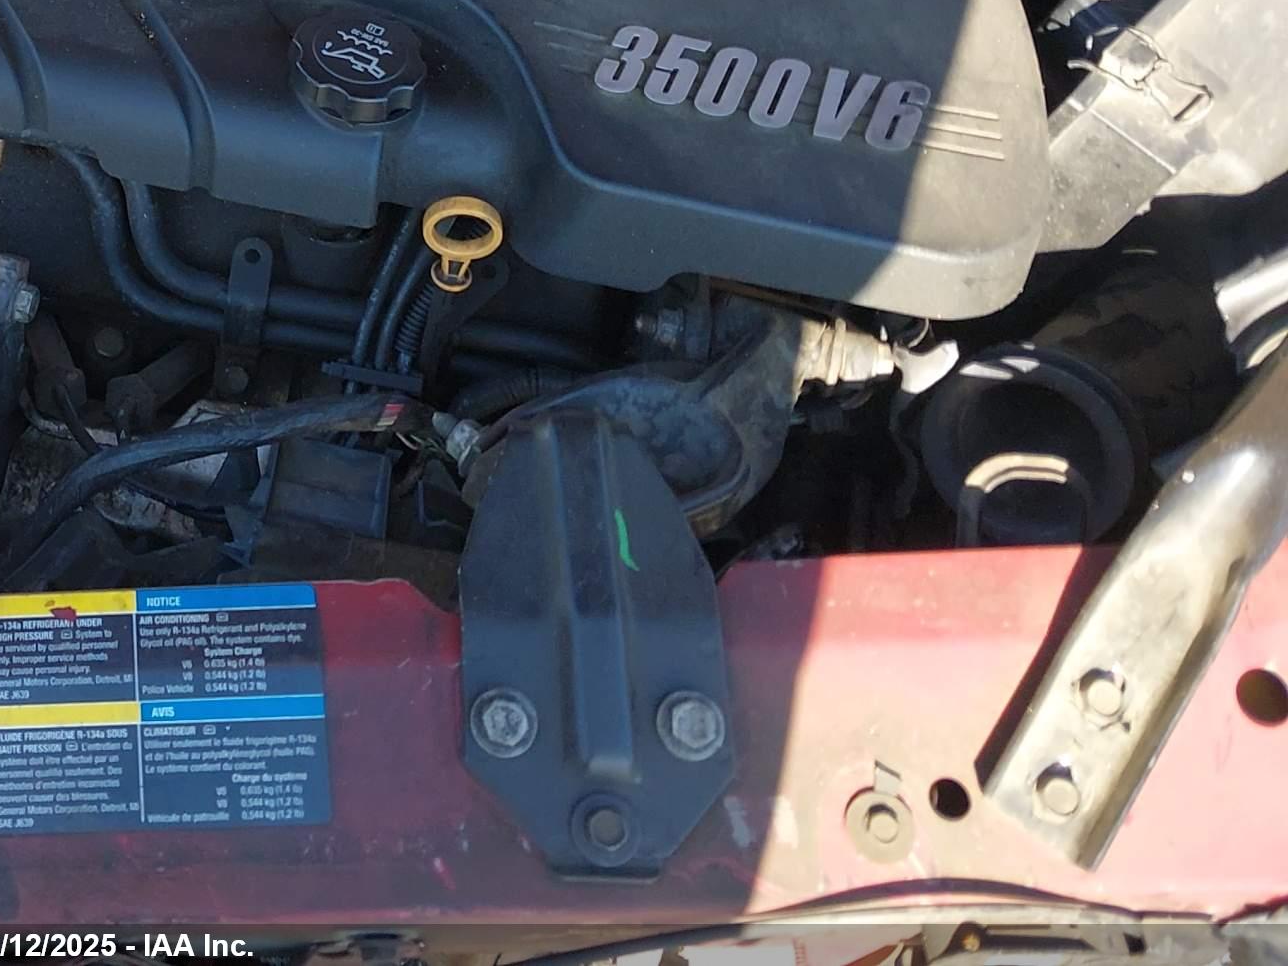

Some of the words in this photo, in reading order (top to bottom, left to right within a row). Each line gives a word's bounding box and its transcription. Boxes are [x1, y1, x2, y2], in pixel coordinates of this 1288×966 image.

[147, 596, 181, 607] NOTICE
[76, 618, 102, 627] UNDER
[139, 615, 152, 625] AIR
[154, 614, 209, 624] CONDITIONING
[14, 631, 53, 641] PRESSURE
[75, 630, 103, 640] System
[140, 627, 154, 636] Use
[156, 627, 171, 638] only
[173, 626, 200, 635] R-134a
[201, 624, 243, 636] Refrigerant
[244, 624, 258, 633] and
[5, 644, 36, 652] serviced
[38, 643, 46, 653] by
[48, 642, 80, 652] qualified
[82, 640, 118, 651] personnel
[140, 639, 162, 649] Glycol
[164, 637, 174, 646] oil
[175, 636, 193, 647] (PAG
[210, 636, 224, 645] The
[226, 636, 252, 646] system
[253, 634, 285, 643] contains
[13, 655, 46, 665] Improper
[48, 654, 74, 662] service
[76, 652, 108, 662] methods
[204, 648, 233, 659] System
[234, 647, 262, 656] Charge
[182, 660, 192, 669] V6
[204, 659, 226, 668] 0.635
[227, 658, 237, 670] kg
[238, 658, 254, 668] (1.4
[255, 657, 265, 667] lb)
[12, 667, 32, 675] cause
[35, 665, 67, 676] personal
[205, 670, 226, 680] 0.544
[228, 670, 238, 682] kg
[239, 669, 254, 680] (1.2
[255, 669, 266, 680] lb)
[24, 678, 48, 686] Motors
[124, 674, 132, 682] MI
[142, 685, 165, 695] Police
[166, 684, 193, 693] Vehicle
[205, 682, 227, 692] 0.544
[229, 682, 239, 694] kg
[240, 681, 255, 692] (1.2
[256, 681, 266, 692] lb)
[11, 690, 29, 700] J639
[151, 706, 175, 718] AVIS
[77, 730, 104, 739] R-134a
[106, 728, 128, 738] SOUS
[144, 726, 196, 736] CLIMATISEUR
[23, 743, 62, 753] PRESSION
[144, 739, 170, 749] Utiliser
[172, 738, 212, 748] seulement
[213, 738, 221, 746] le
[222, 737, 243, 746] fluide
[289, 735, 316, 744] R-134a
[232, 773, 260, 783] Charge
[263, 773, 272, 782] du
